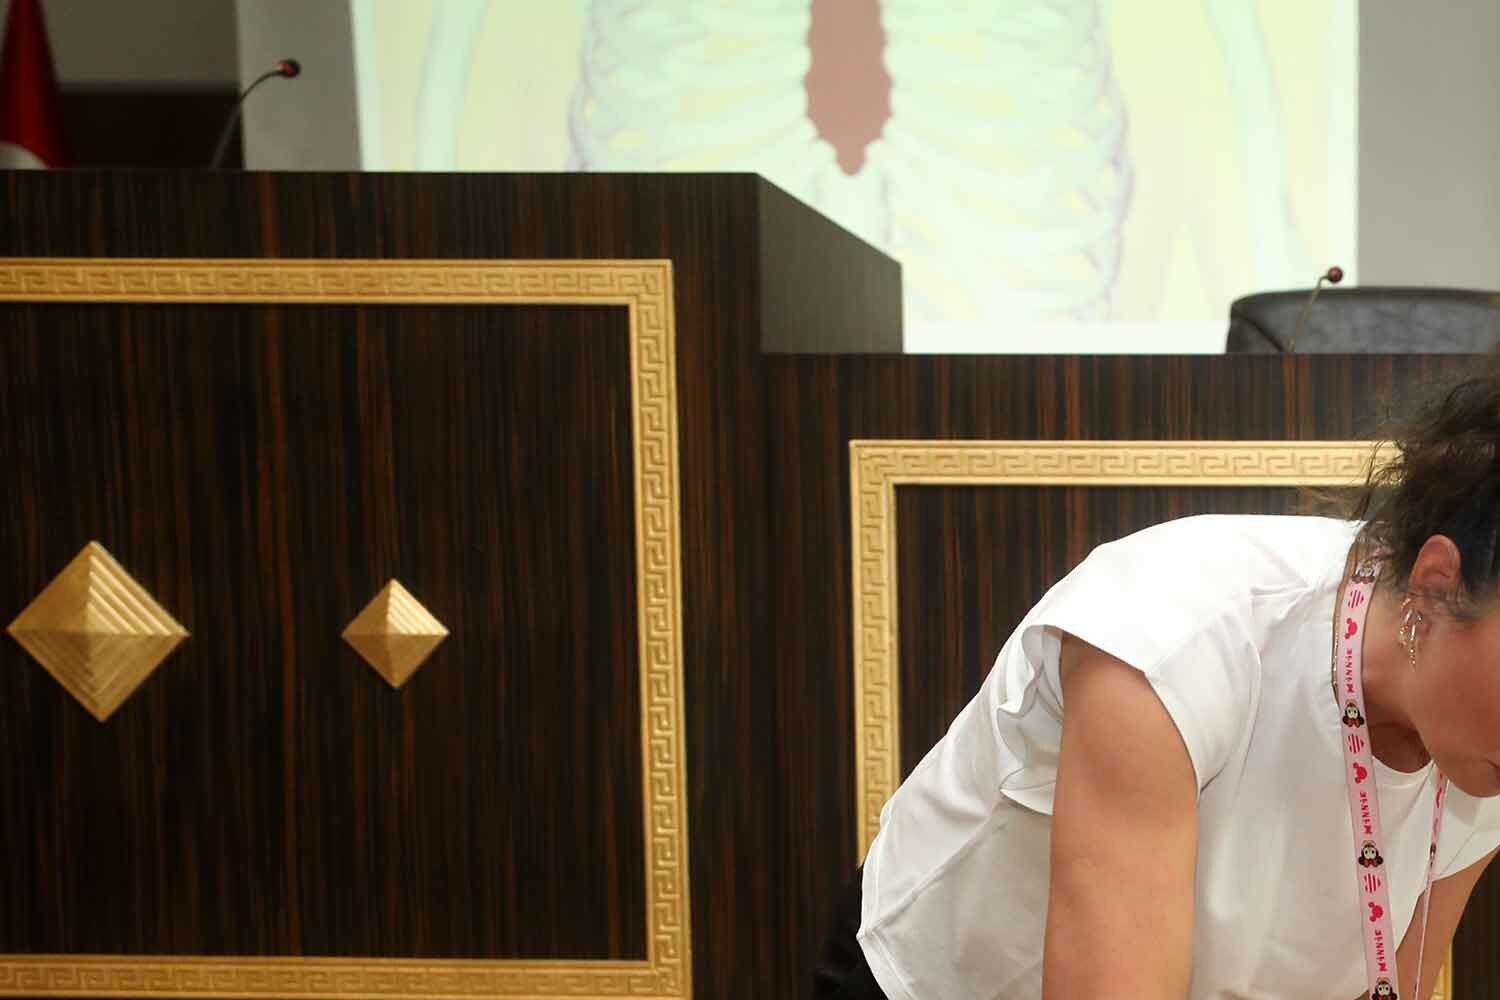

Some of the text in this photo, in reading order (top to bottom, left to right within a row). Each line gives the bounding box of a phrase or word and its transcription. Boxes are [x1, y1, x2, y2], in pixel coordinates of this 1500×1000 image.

[1344, 649, 1355, 693] MINNIE
[1359, 791, 1373, 835] MINNIE
[1374, 929, 1388, 972] MINNIE
